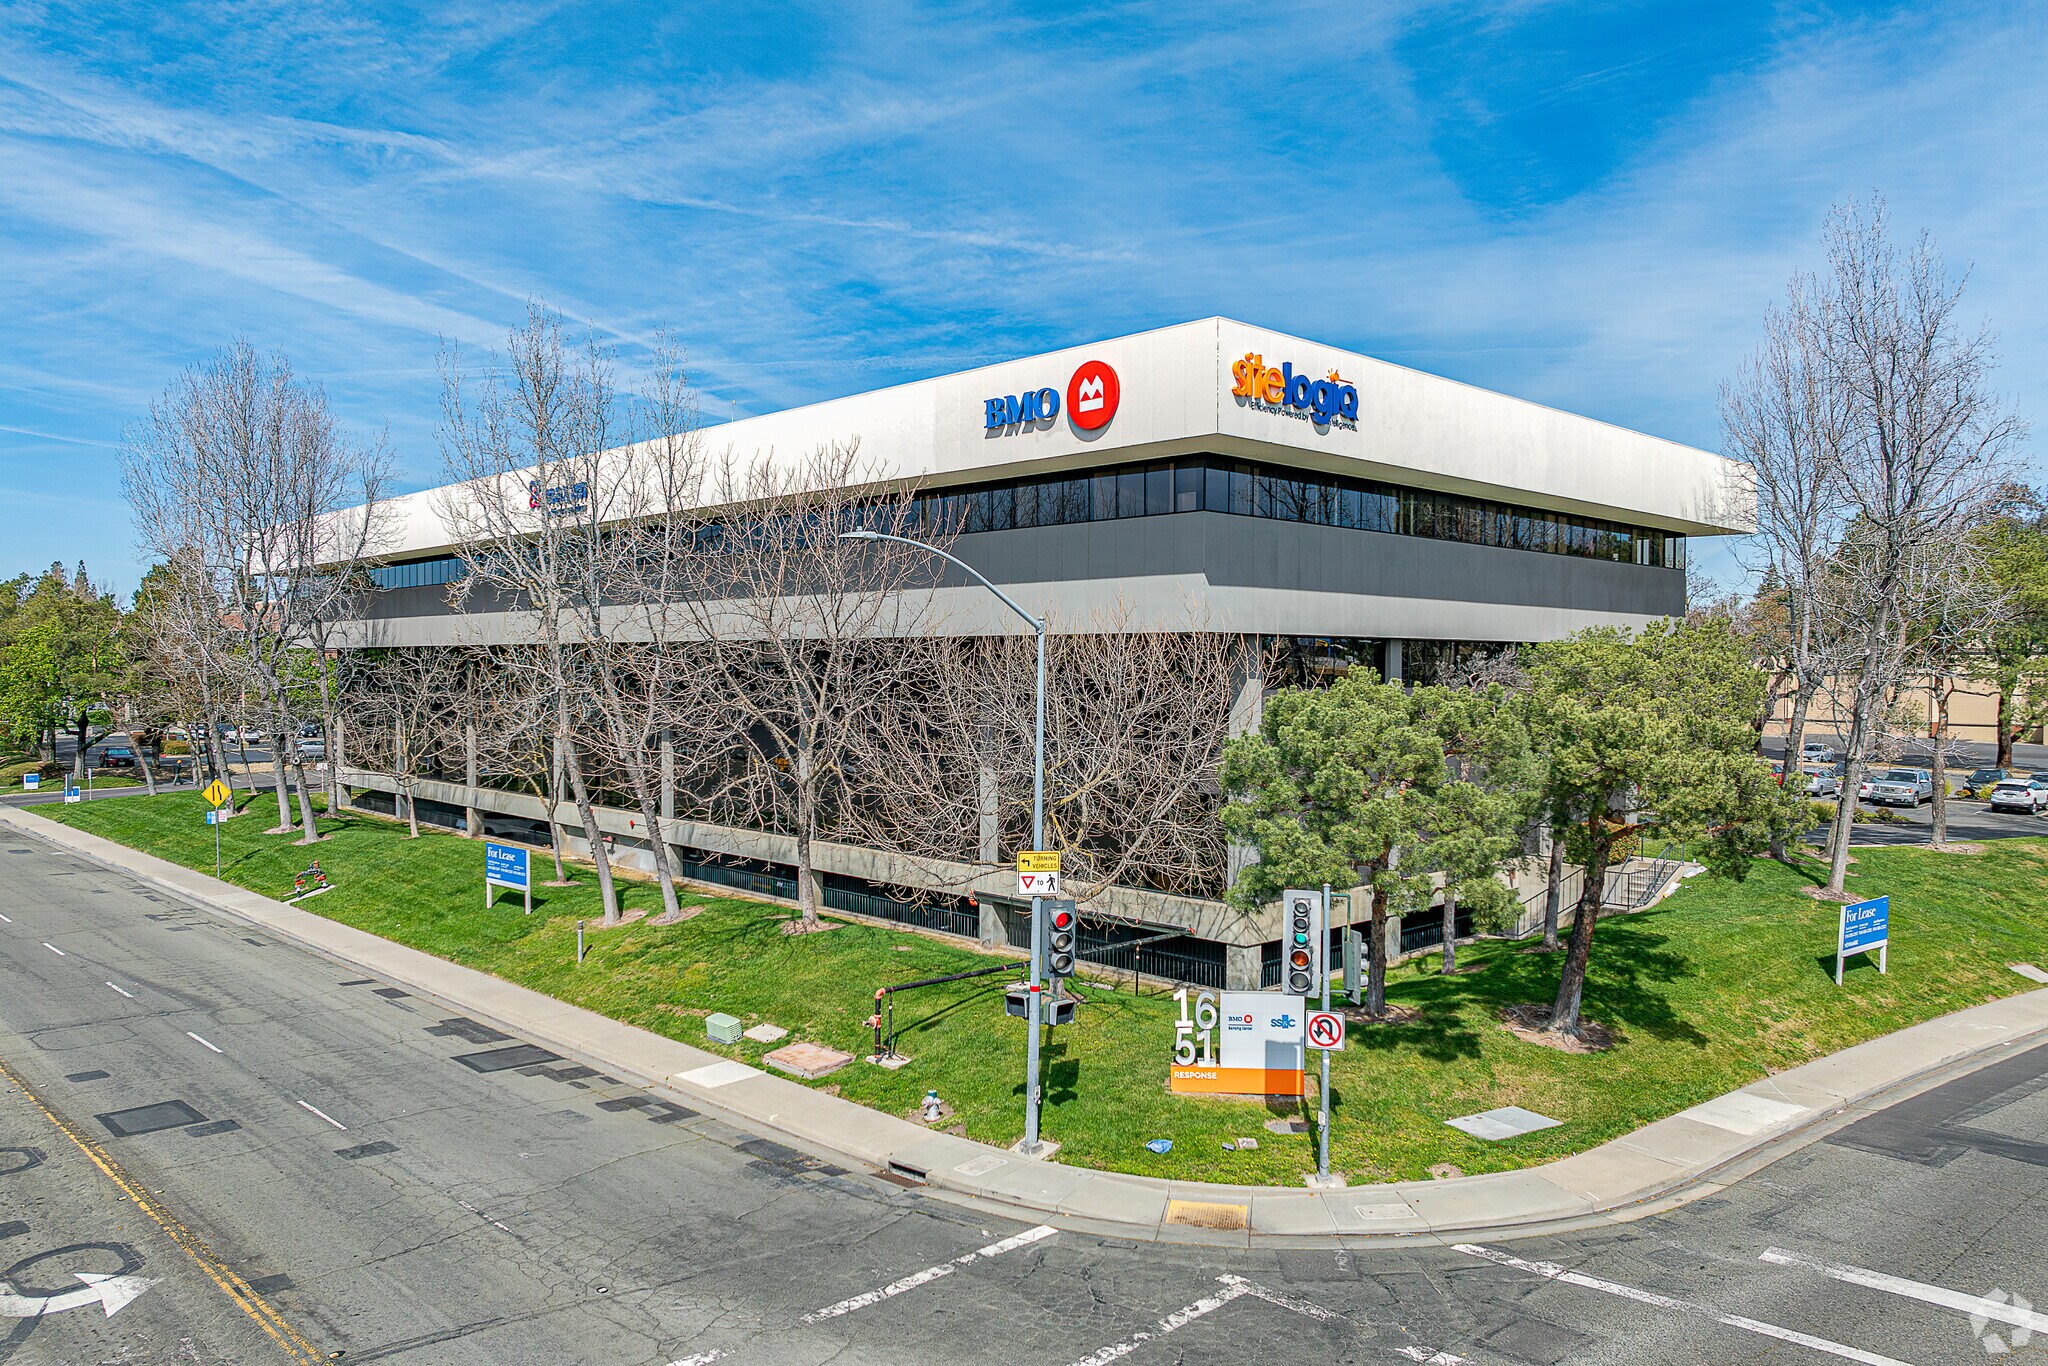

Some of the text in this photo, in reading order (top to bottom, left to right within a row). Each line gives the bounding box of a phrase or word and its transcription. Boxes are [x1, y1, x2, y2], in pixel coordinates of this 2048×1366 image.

[984, 387, 1061, 429] BMO
[487, 846, 516, 862] For Lease
[1846, 909, 1858, 923] For
[1858, 907, 1877, 920] Lease
[1173, 988, 1218, 1030] 16
[1270, 1014, 1296, 1029] SS&C
[1175, 1027, 1216, 1068] 51
[1174, 1071, 1217, 1080] RESPONSE
